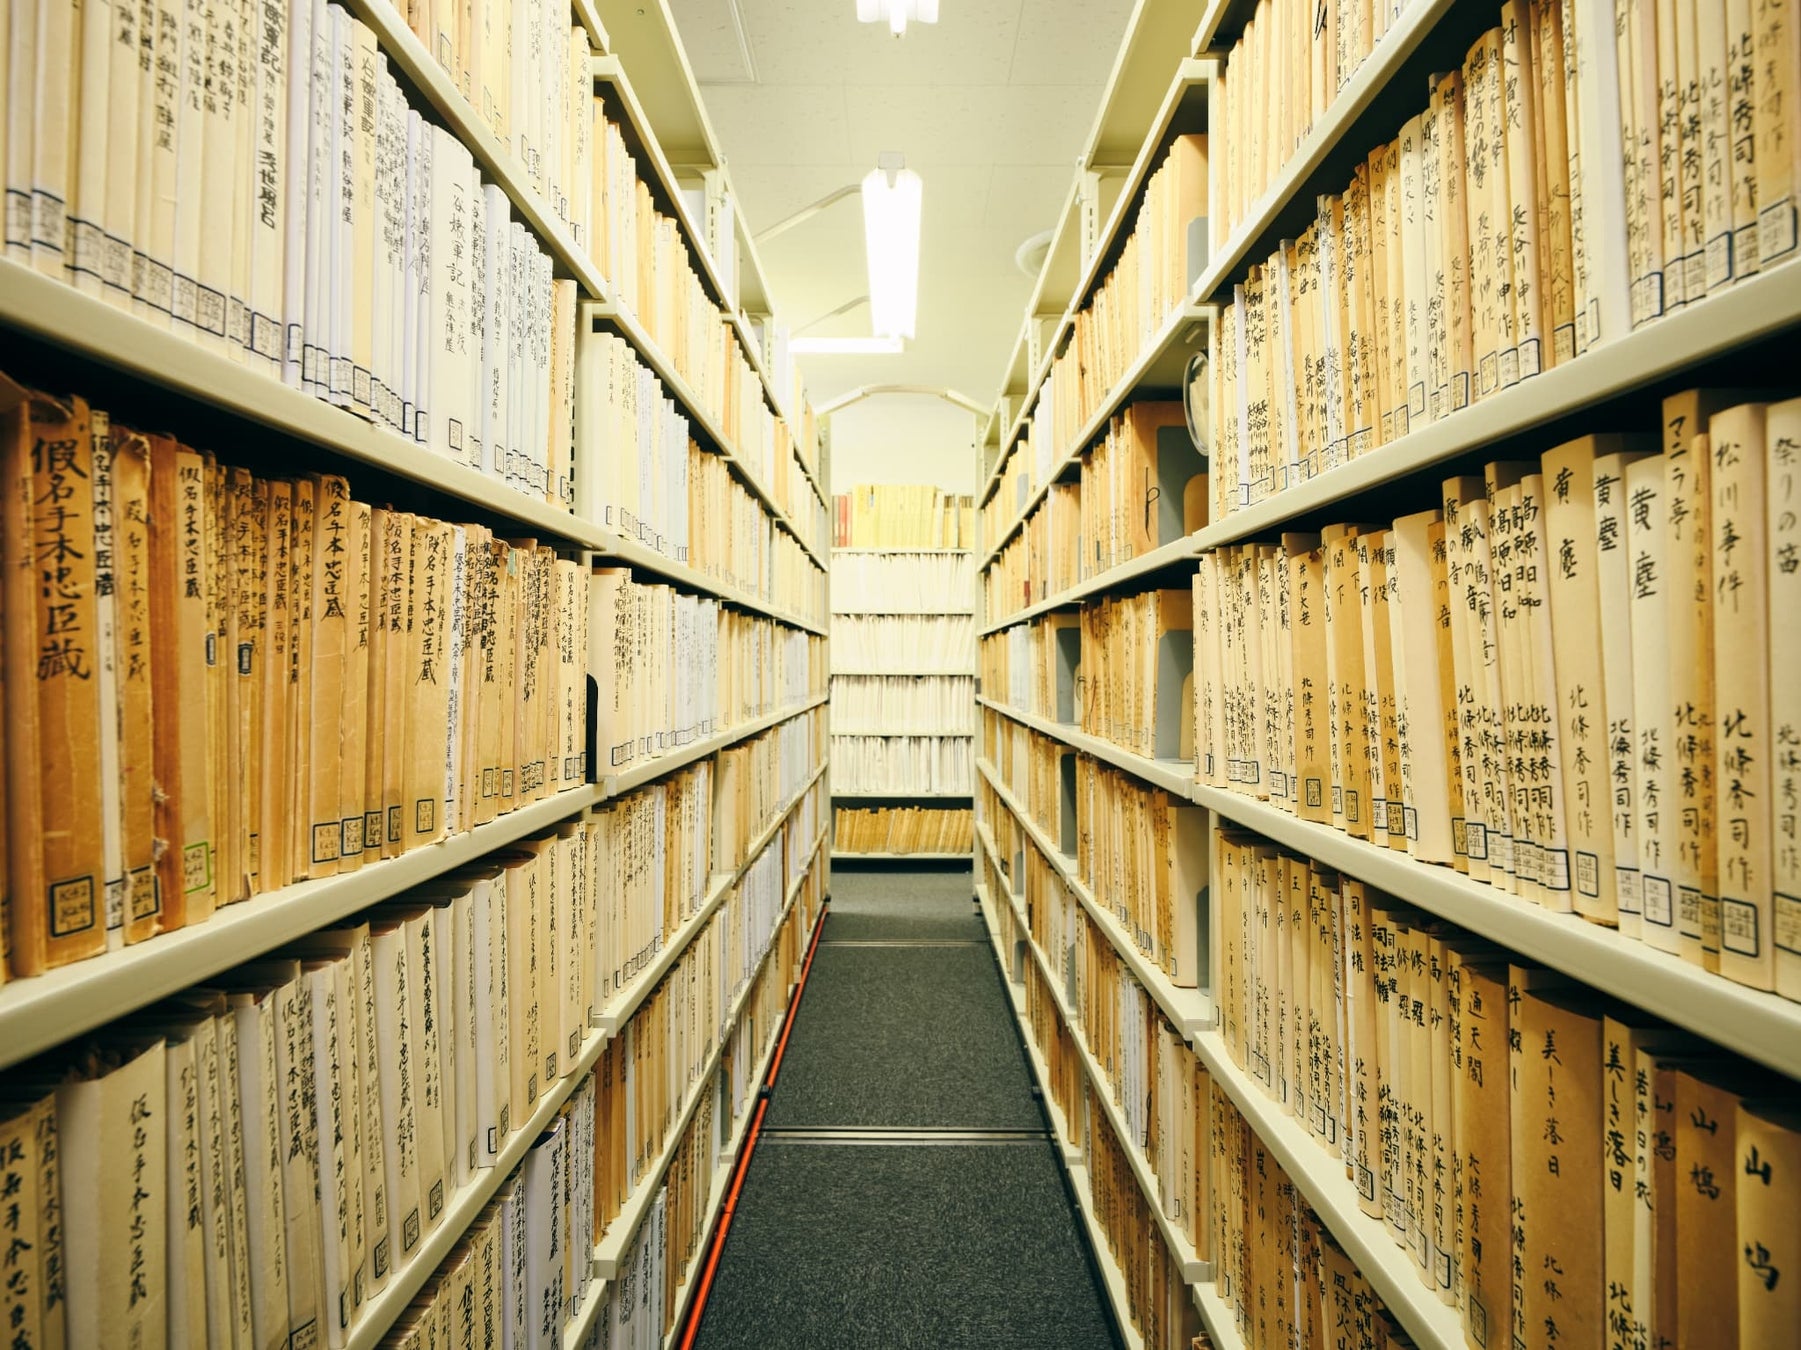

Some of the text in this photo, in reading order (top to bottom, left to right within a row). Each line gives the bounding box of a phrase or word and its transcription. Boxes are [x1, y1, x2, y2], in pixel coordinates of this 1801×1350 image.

[1715, 441, 1745, 614] 松川事件
[1467, 990, 1488, 1089] 通天閣
[1544, 1254, 1566, 1350] 北條秀
